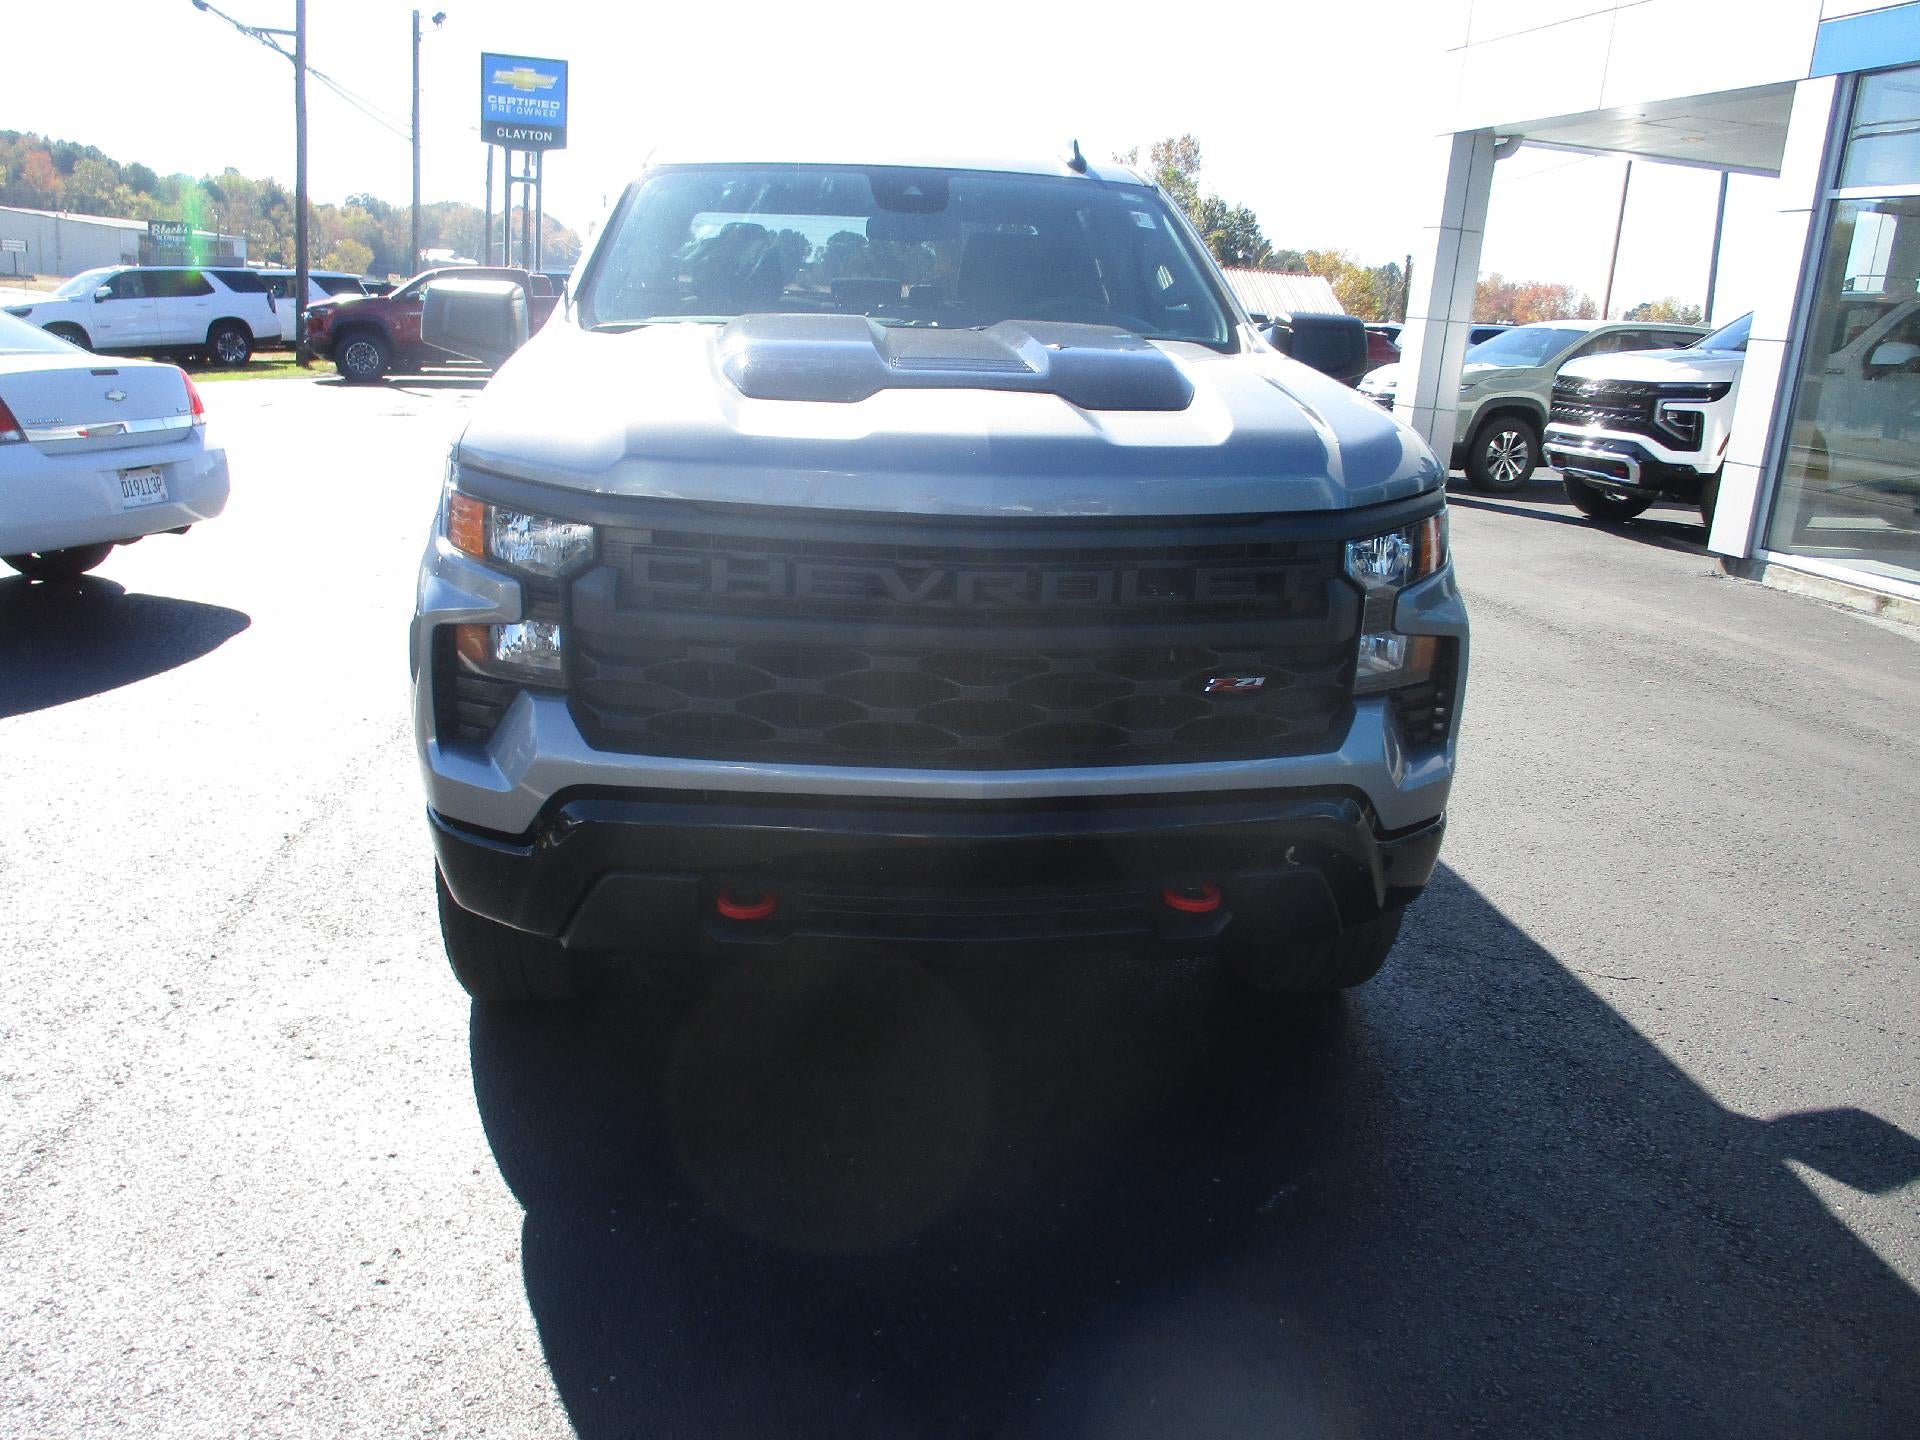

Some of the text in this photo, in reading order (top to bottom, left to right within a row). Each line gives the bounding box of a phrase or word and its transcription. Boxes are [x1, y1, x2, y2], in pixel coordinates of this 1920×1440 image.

[487, 95, 560, 110] CERTIFIED
[496, 127, 552, 142] CLAYTON
[632, 550, 1318, 607] CHEVROLET
[1203, 676, 1266, 693] Z71
